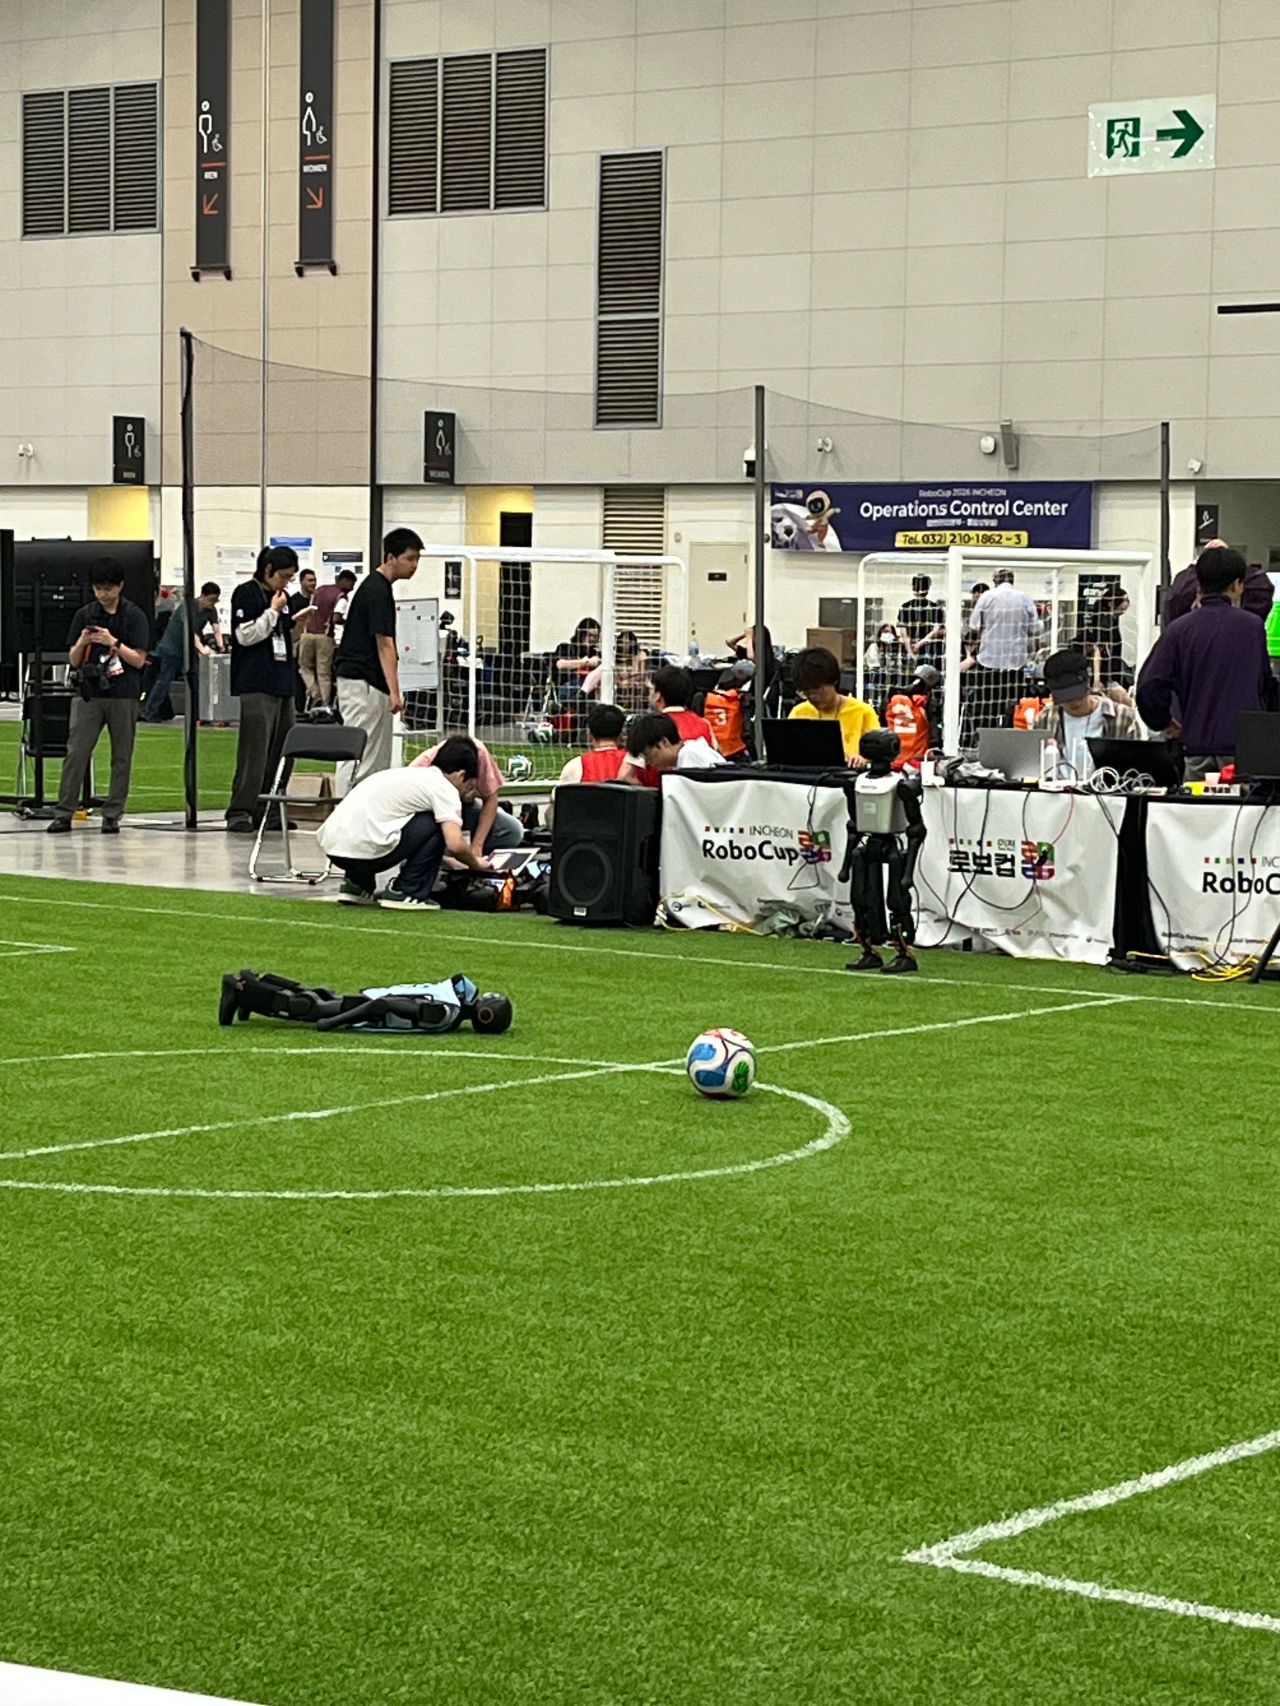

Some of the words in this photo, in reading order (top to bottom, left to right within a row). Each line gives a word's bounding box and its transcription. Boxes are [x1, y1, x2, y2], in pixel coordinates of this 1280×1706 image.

[860, 500, 948, 521] Operations
[950, 500, 1010, 516] Control
[1012, 500, 1069, 516] Center
[712, 708, 728, 727] 3
[749, 825, 794, 839] INCHEON
[702, 839, 799, 866] RoboCup
[947, 849, 1016, 878] 로보컵
